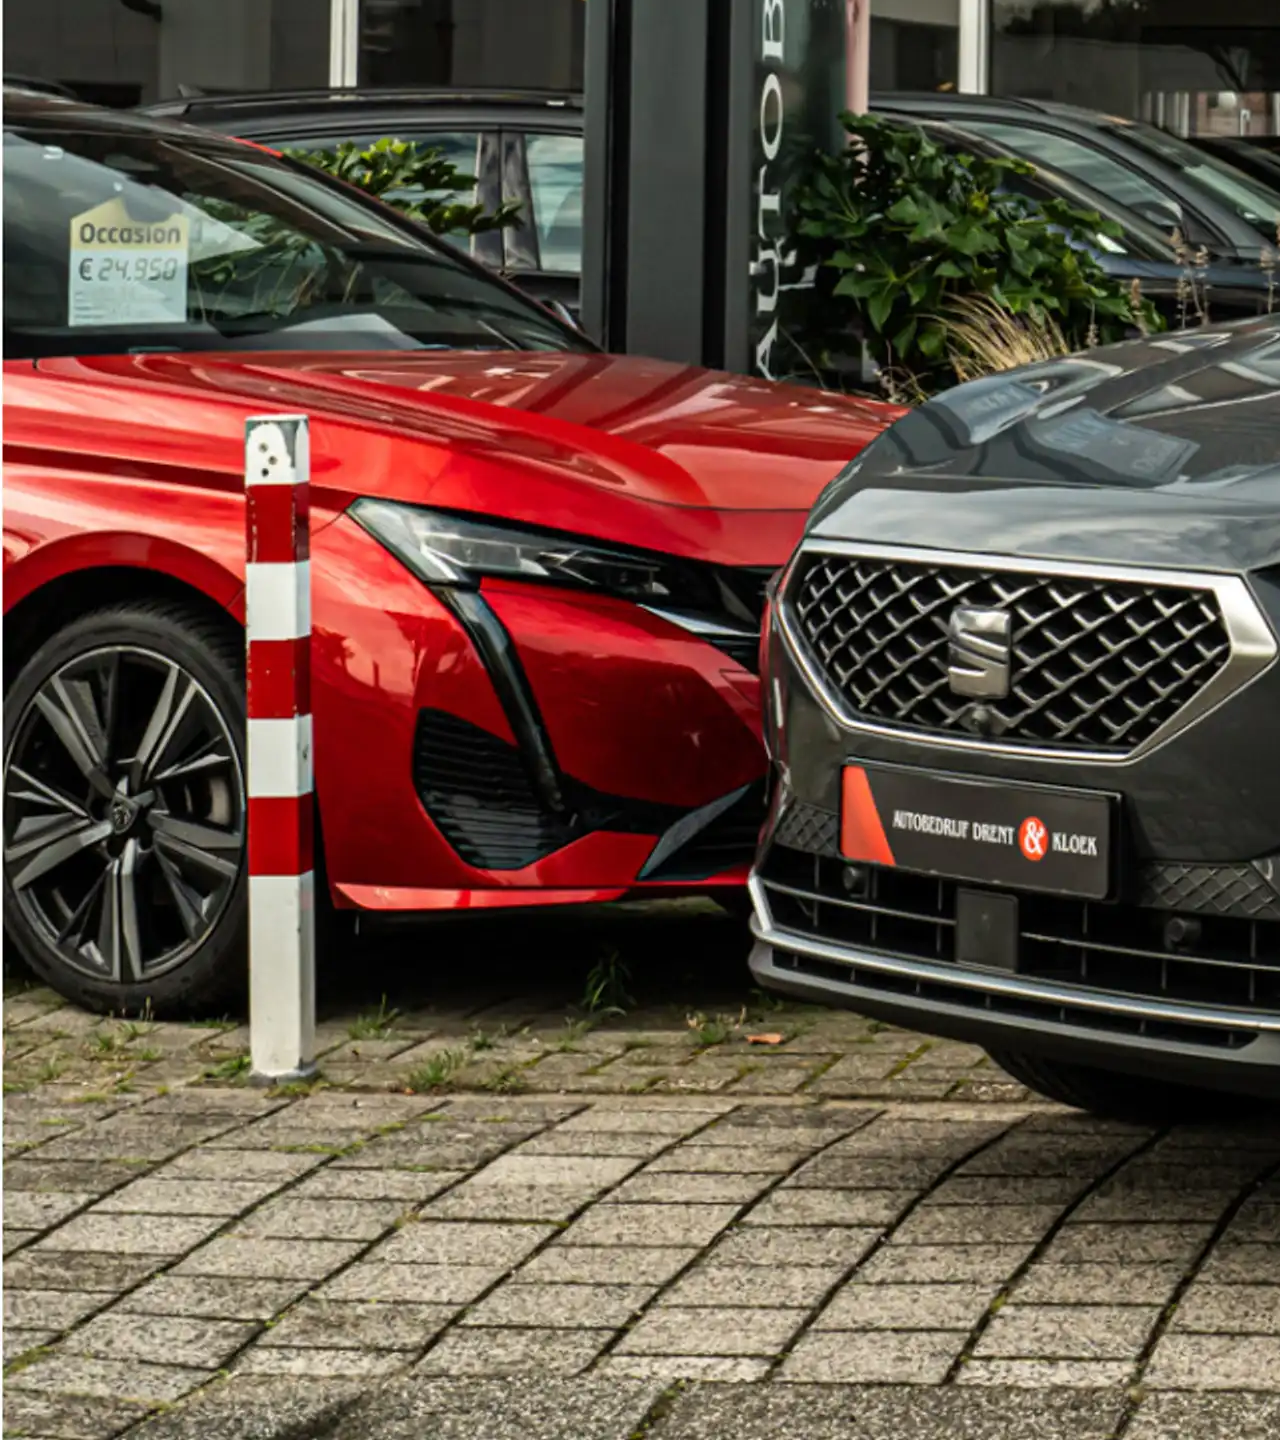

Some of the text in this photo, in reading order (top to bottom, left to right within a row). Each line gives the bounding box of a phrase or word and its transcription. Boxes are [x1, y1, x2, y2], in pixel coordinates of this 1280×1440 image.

[80, 222, 181, 244] Occasion
[893, 810, 1097, 857] AUTOBEDRIJF DRENT & KLOEK
